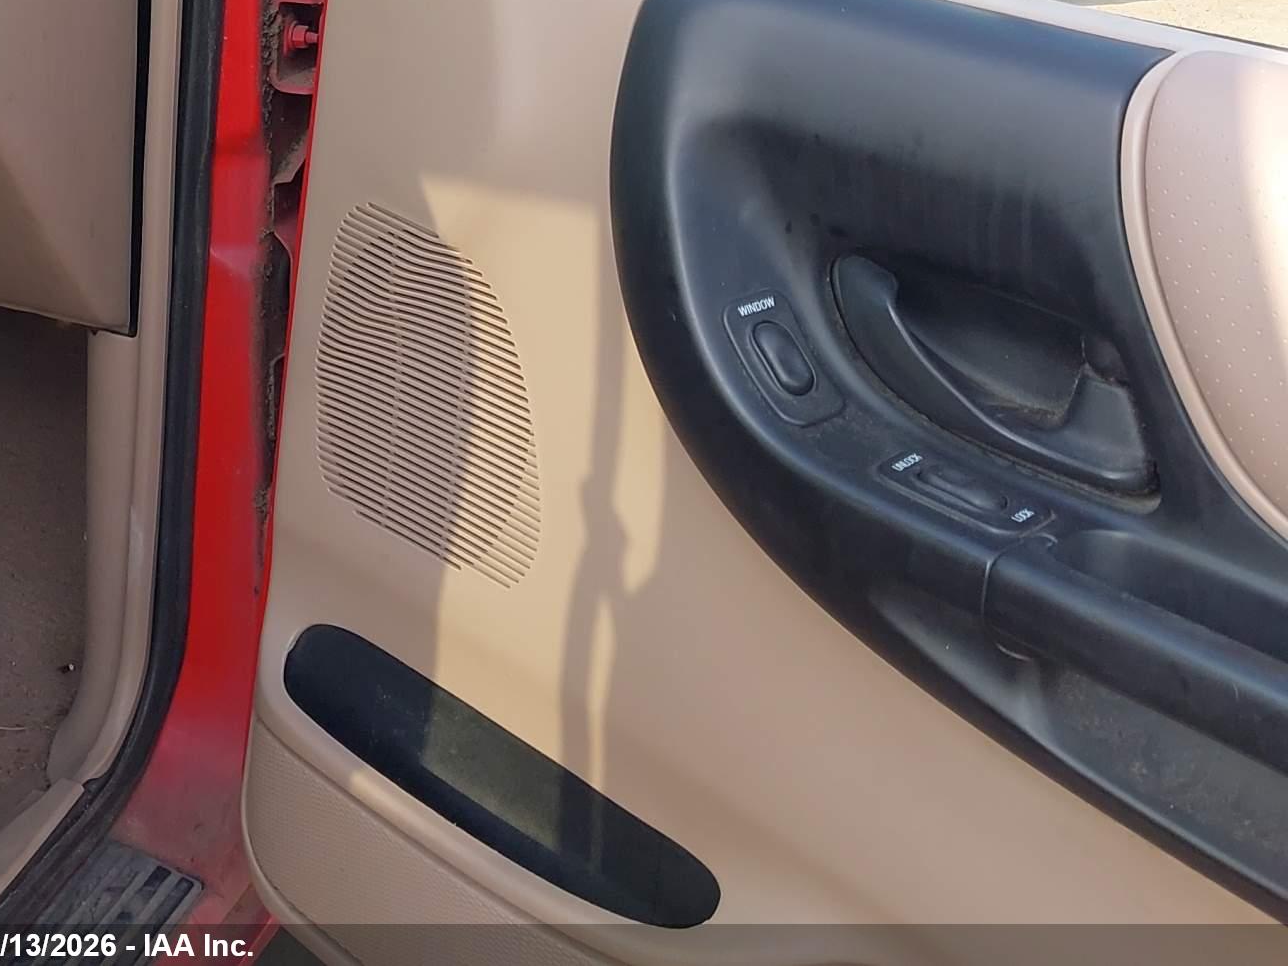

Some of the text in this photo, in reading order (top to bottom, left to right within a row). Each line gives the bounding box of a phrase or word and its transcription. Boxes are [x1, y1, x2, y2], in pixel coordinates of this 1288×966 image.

[737, 295, 775, 317] WINDOW
[891, 452, 923, 472] UNLOCK
[1010, 508, 1035, 523] LOCK
